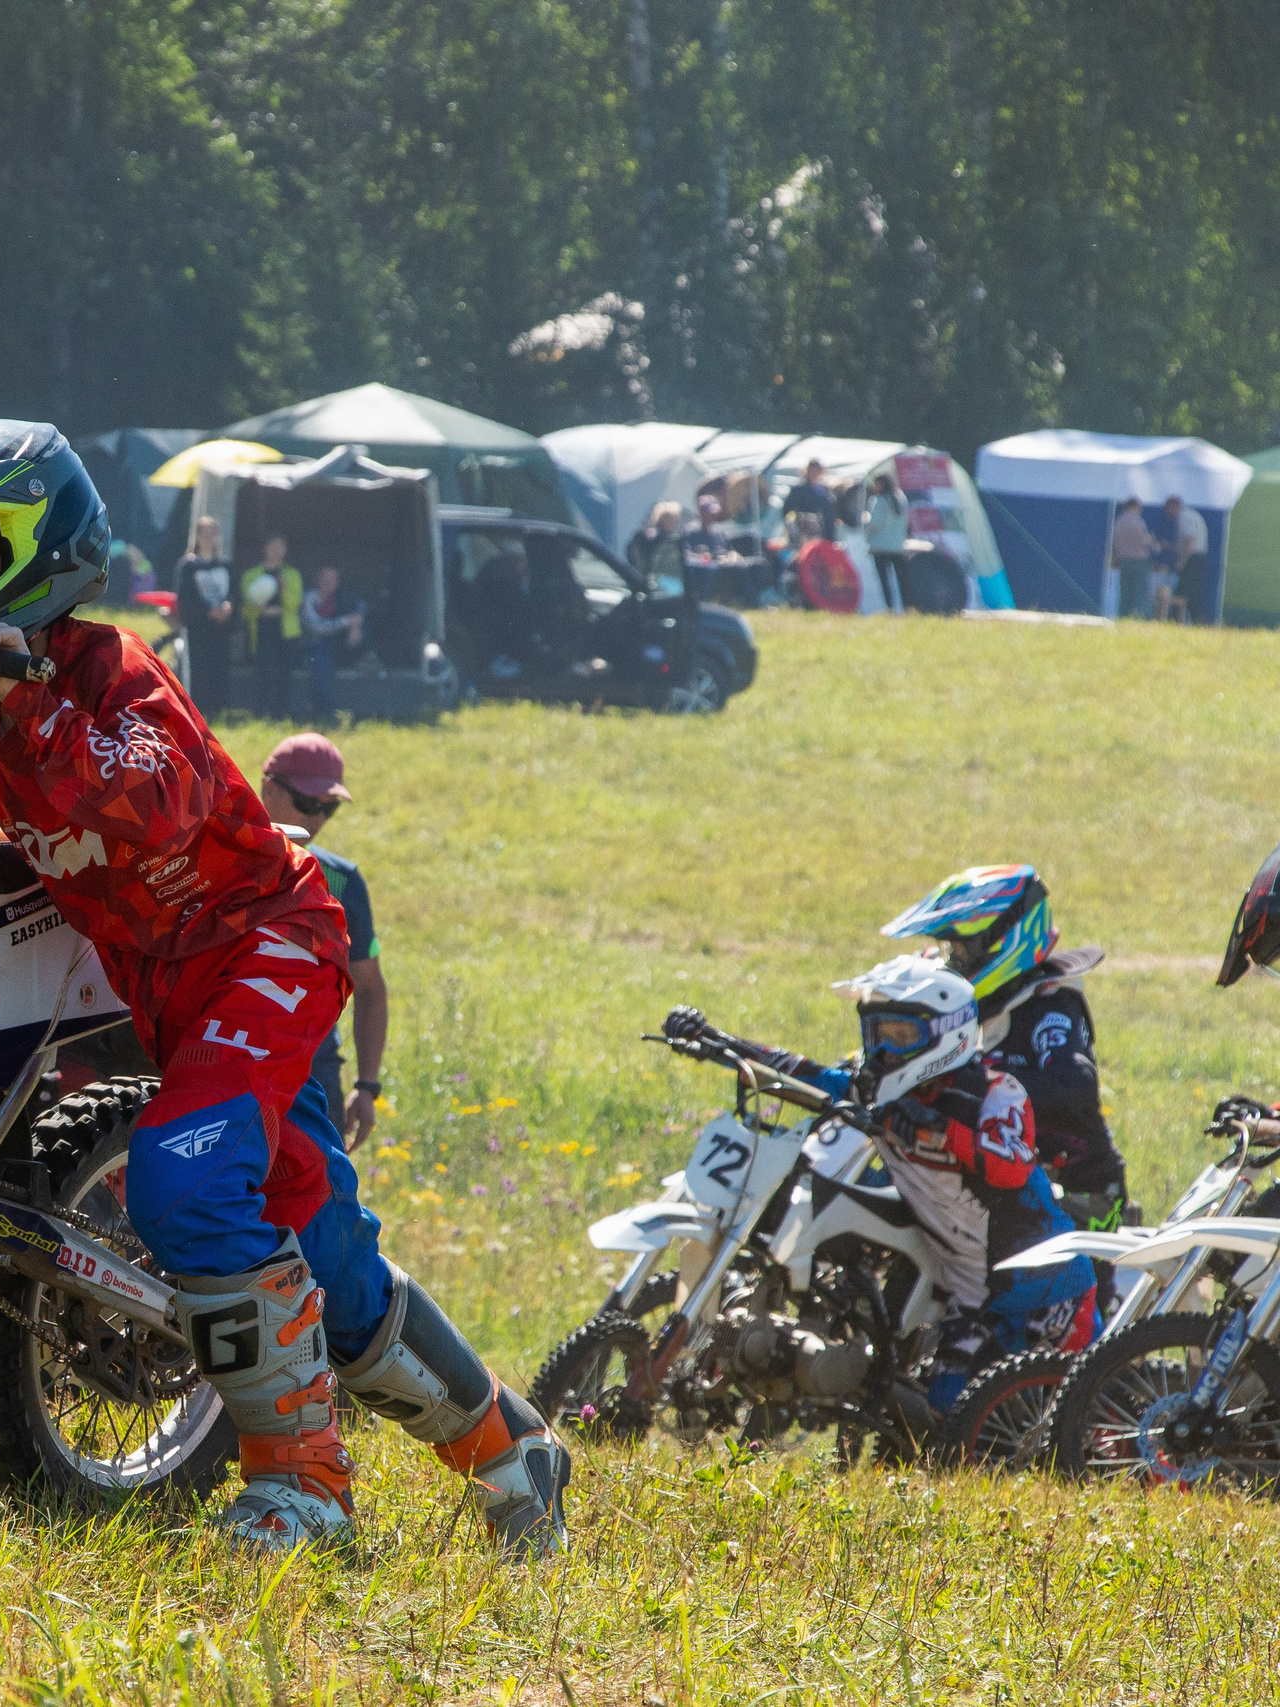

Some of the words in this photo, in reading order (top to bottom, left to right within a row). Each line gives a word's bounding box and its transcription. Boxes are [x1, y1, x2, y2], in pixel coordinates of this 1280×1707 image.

[166, 879, 212, 907] MOLECULE
[700, 1133, 752, 1188] 72
[113, 1276, 144, 1298] brembo
